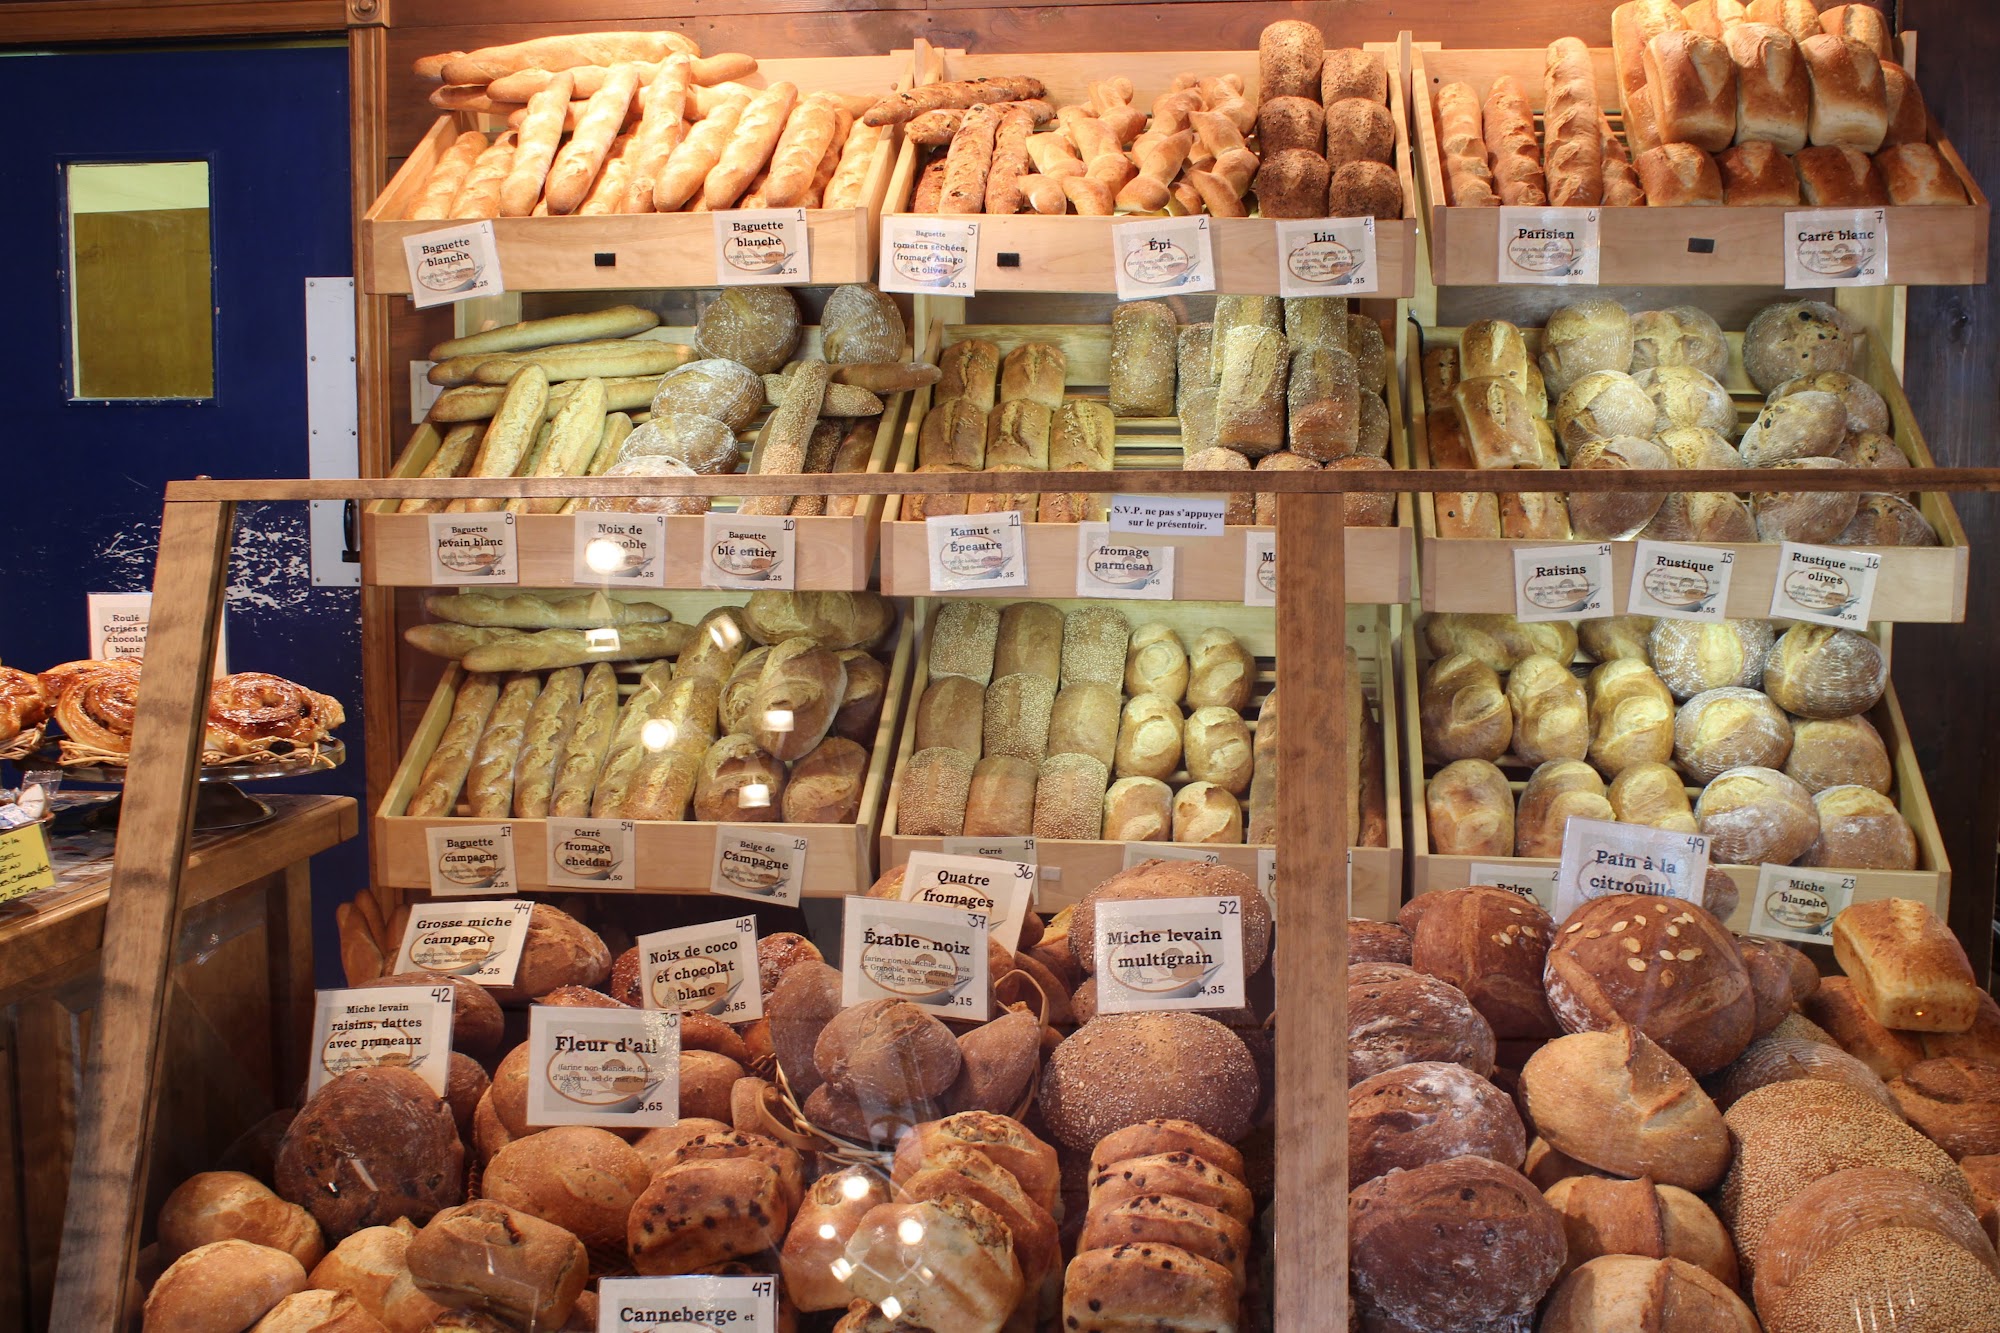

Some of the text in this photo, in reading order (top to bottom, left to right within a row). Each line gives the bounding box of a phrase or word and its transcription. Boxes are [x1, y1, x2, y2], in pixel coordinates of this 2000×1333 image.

[796, 208, 806, 222] 1
[1586, 211, 1596, 222] 6
[1874, 210, 1884, 224] 7
[481, 223, 489, 234] 1
[966, 224, 977, 236] 5
[1198, 218, 1208, 230] 2
[732, 221, 784, 243] Baguette
[915, 230, 947, 240] Baguette
[1313, 232, 1337, 243] Lin
[1518, 228, 1575, 240] Parisien
[1797, 230, 1875, 243] Carré blanc
[422, 238, 471, 255] Baguette
[736, 237, 783, 248] blanche
[892, 241, 969, 253] tomates séchées,
[1148, 238, 1172, 253] Épi
[427, 252, 470, 268] blanche
[896, 252, 964, 265] fromage Asiago
[780, 266, 798, 275] 2,25
[910, 265, 948, 275] et olives
[950, 281, 967, 290] 3,15
[505, 512, 514, 525] 8
[1113, 505, 1143, 516] S.V.P.
[1158, 508, 1175, 518] pas
[1176, 508, 1224, 522] s'appuyer
[656, 516, 664, 527] 9
[782, 519, 795, 531] 10
[1008, 514, 1020, 527] 11
[1146, 519, 1155, 528] le
[1157, 519, 1207, 531] présentoir.
[451, 526, 489, 536] Baguette
[597, 523, 643, 535] Noix de
[950, 526, 989, 538] Kamut
[728, 531, 767, 541] Baguette
[438, 538, 504, 548] levain blanc
[950, 541, 1003, 555] Épeautre
[717, 545, 777, 558] blé entier
[1099, 546, 1150, 559] fromage
[1598, 544, 1612, 556] 14
[1656, 555, 1714, 573] Rustique
[1720, 552, 1735, 564] 15
[1792, 552, 1847, 571] Rustique
[1865, 558, 1880, 570] 16
[1094, 560, 1154, 572] parmesan
[1535, 564, 1587, 577] Raisins
[1807, 571, 1844, 586] olives
[112, 614, 140, 623] Roulé
[1840, 612, 1858, 621] 3,95
[103, 624, 138, 633] Cerises
[115, 645, 141, 653] blanc
[501, 826, 513, 838] 17
[574, 828, 601, 838] Carré
[621, 821, 634, 833] 54
[446, 838, 495, 850] Baguette
[564, 841, 611, 855] fromage
[740, 840, 776, 854] Belge de
[792, 838, 807, 851] 18
[978, 846, 1003, 855] Carré
[1023, 840, 1034, 850] 19
[1686, 836, 1705, 855] 49
[445, 853, 499, 865] campagne
[565, 856, 612, 868] cheddar
[723, 850, 789, 871] Campagne
[1595, 849, 1677, 874] Pain à la
[1013, 863, 1034, 880] 36
[937, 870, 991, 887] Quatre
[1841, 878, 1855, 890] 23
[1789, 878, 1825, 893] Miche
[923, 889, 995, 910] fromages
[1781, 892, 1828, 908] blanche
[514, 902, 532, 915] 44
[1217, 900, 1240, 915] 52
[416, 916, 513, 930] Grosse miche
[735, 918, 753, 933] 48
[967, 913, 987, 930] 37
[423, 934, 496, 946] campagne
[863, 928, 921, 949] Érable
[932, 940, 971, 956] noix
[1107, 927, 1223, 946] Miche levain
[649, 940, 738, 965] Noix de coco
[1117, 951, 1214, 969] multigrain
[477, 966, 501, 977] 6,25
[656, 959, 735, 984] et chocolat
[955, 965, 971, 974] noix
[431, 988, 452, 1004] 42
[677, 985, 716, 1001] blanc
[1198, 985, 1226, 997] 4,35
[724, 1001, 747, 1014] 3,85
[948, 995, 973, 1007] 3,15
[346, 1003, 409, 1014] Miche levain
[331, 1017, 423, 1033] raisins, dattes
[329, 1036, 422, 1051] avec pruneaux
[554, 1035, 658, 1054] Fleur d'ail
[591, 1073, 603, 1082] sel
[604, 1073, 613, 1082] de
[637, 1100, 664, 1112] 3,65
[751, 1281, 772, 1298] 47
[620, 1305, 755, 1326] Canneberge et
